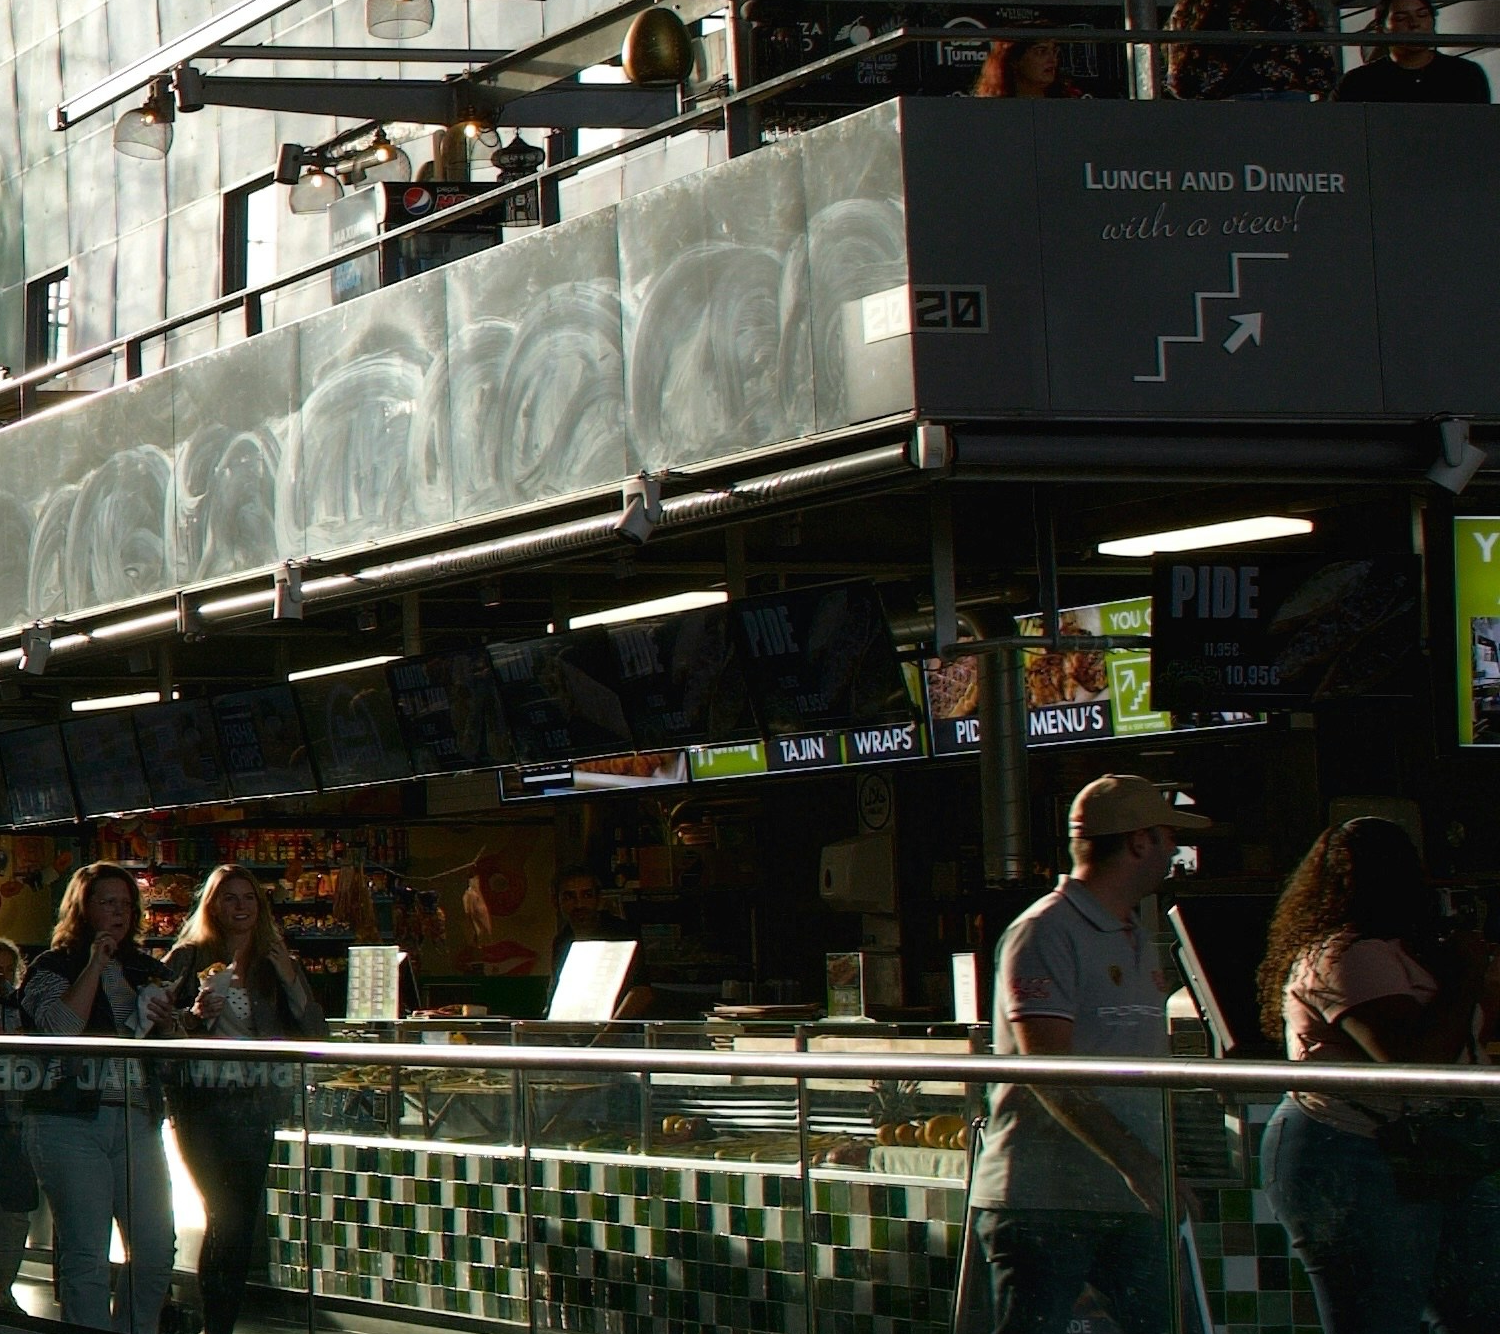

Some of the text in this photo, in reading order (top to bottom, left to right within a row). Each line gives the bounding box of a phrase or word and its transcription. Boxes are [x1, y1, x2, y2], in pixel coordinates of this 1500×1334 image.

[1101, 202, 1180, 241] with
[1186, 218, 1211, 238] a
[915, 290, 982, 328] 20
[1172, 565, 1260, 619] PIDE
[741, 605, 799, 658] PIDE
[1109, 609, 1141, 630] YOU
[955, 718, 981, 744] PID
[1028, 704, 1104, 737] MENU'S
[780, 736, 825, 763] TAJIN
[853, 727, 913, 755] WRAPS
